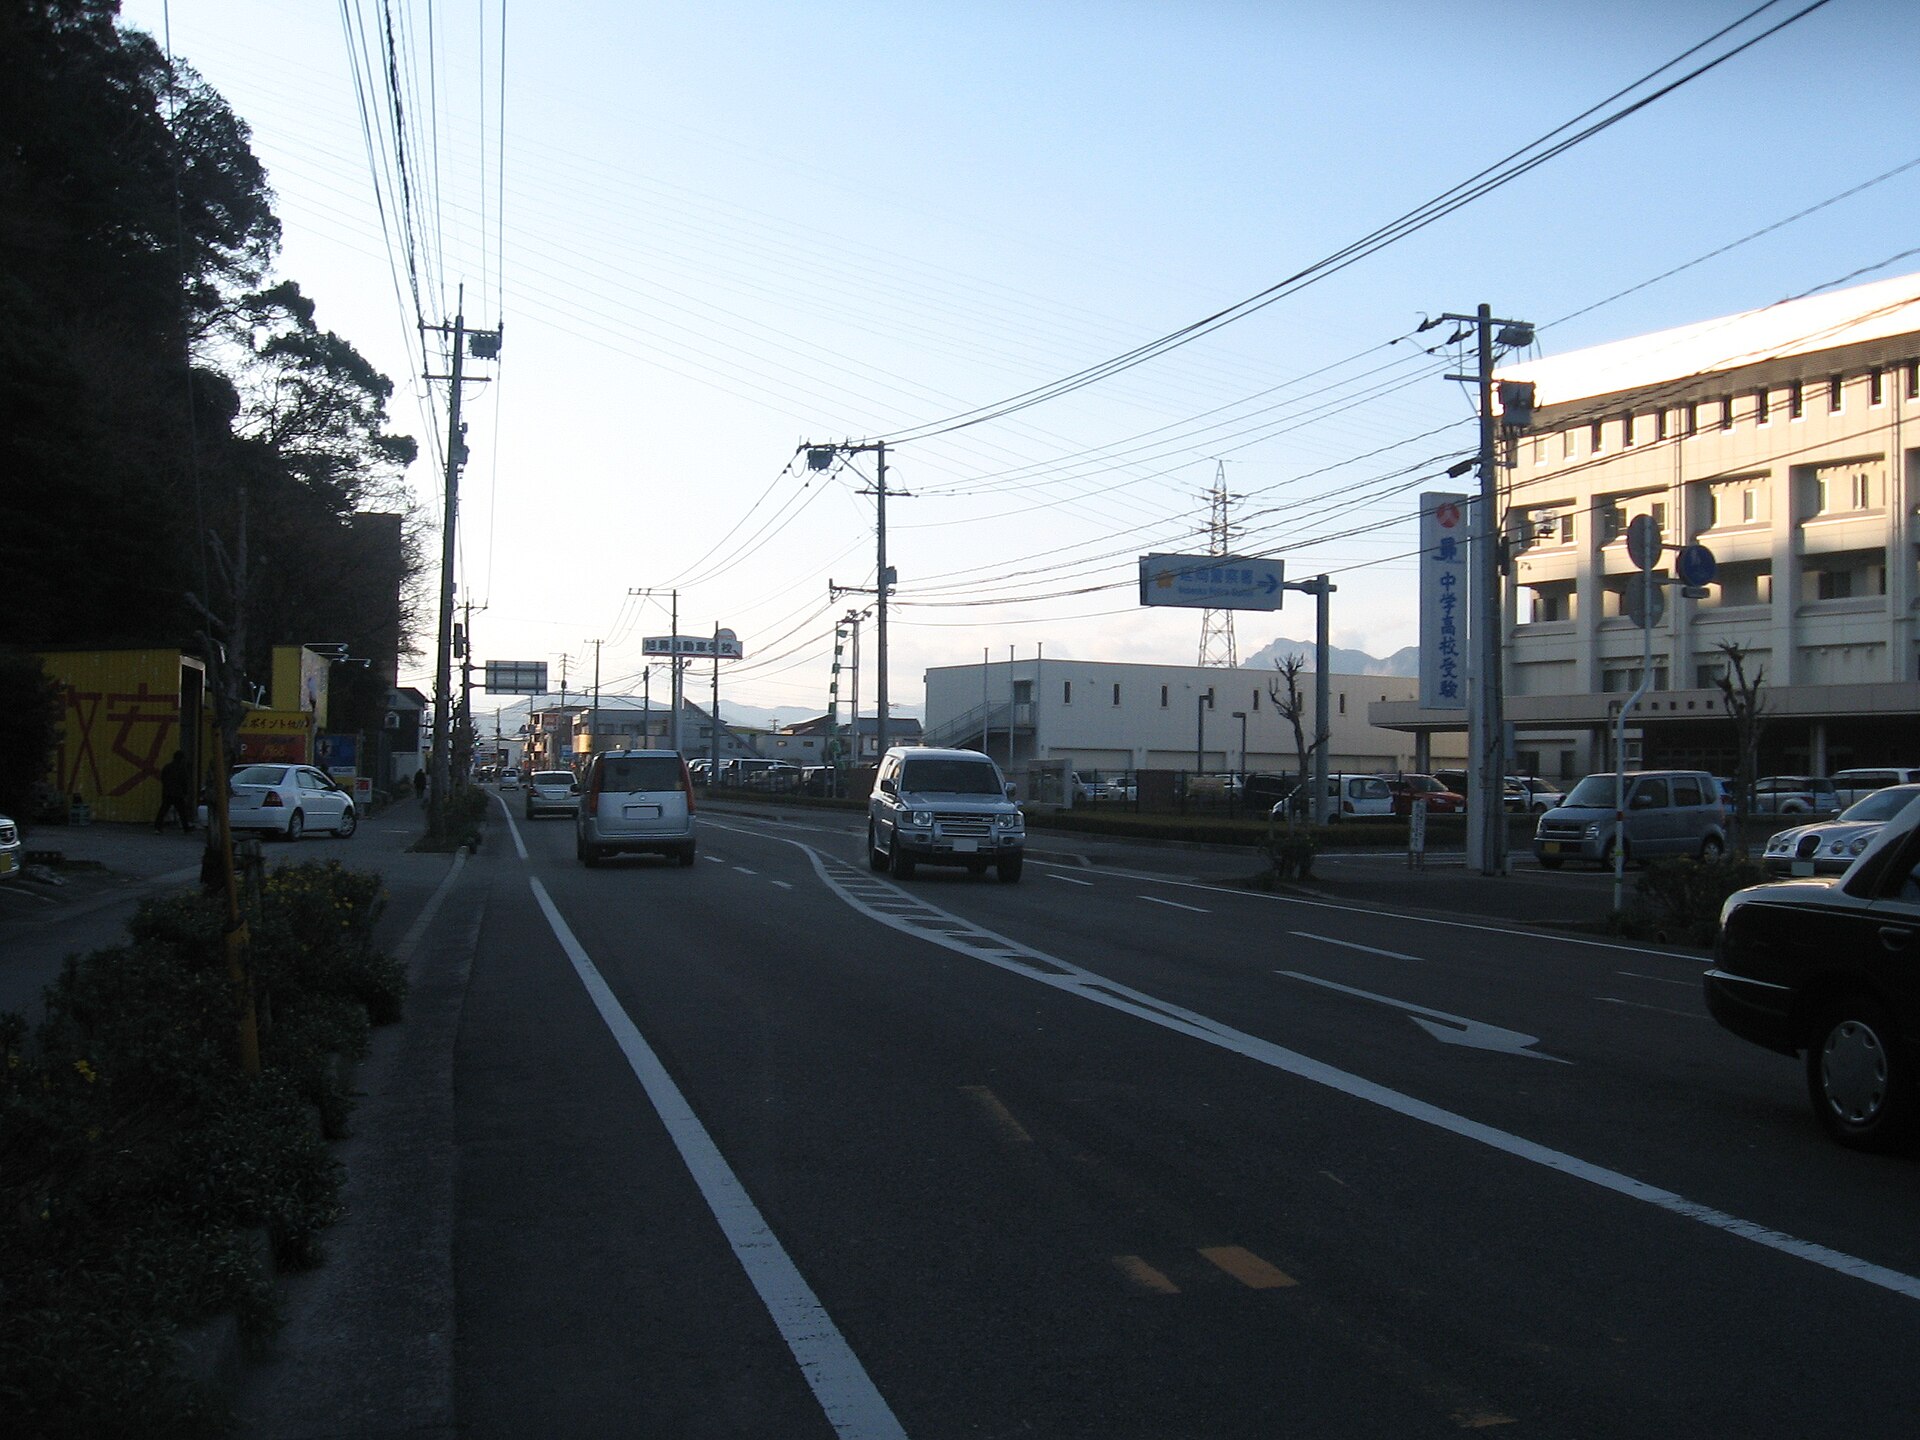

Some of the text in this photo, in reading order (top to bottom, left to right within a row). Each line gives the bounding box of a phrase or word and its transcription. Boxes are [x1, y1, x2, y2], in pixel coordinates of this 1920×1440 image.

[1438, 571, 1460, 699] 中学高校受験
